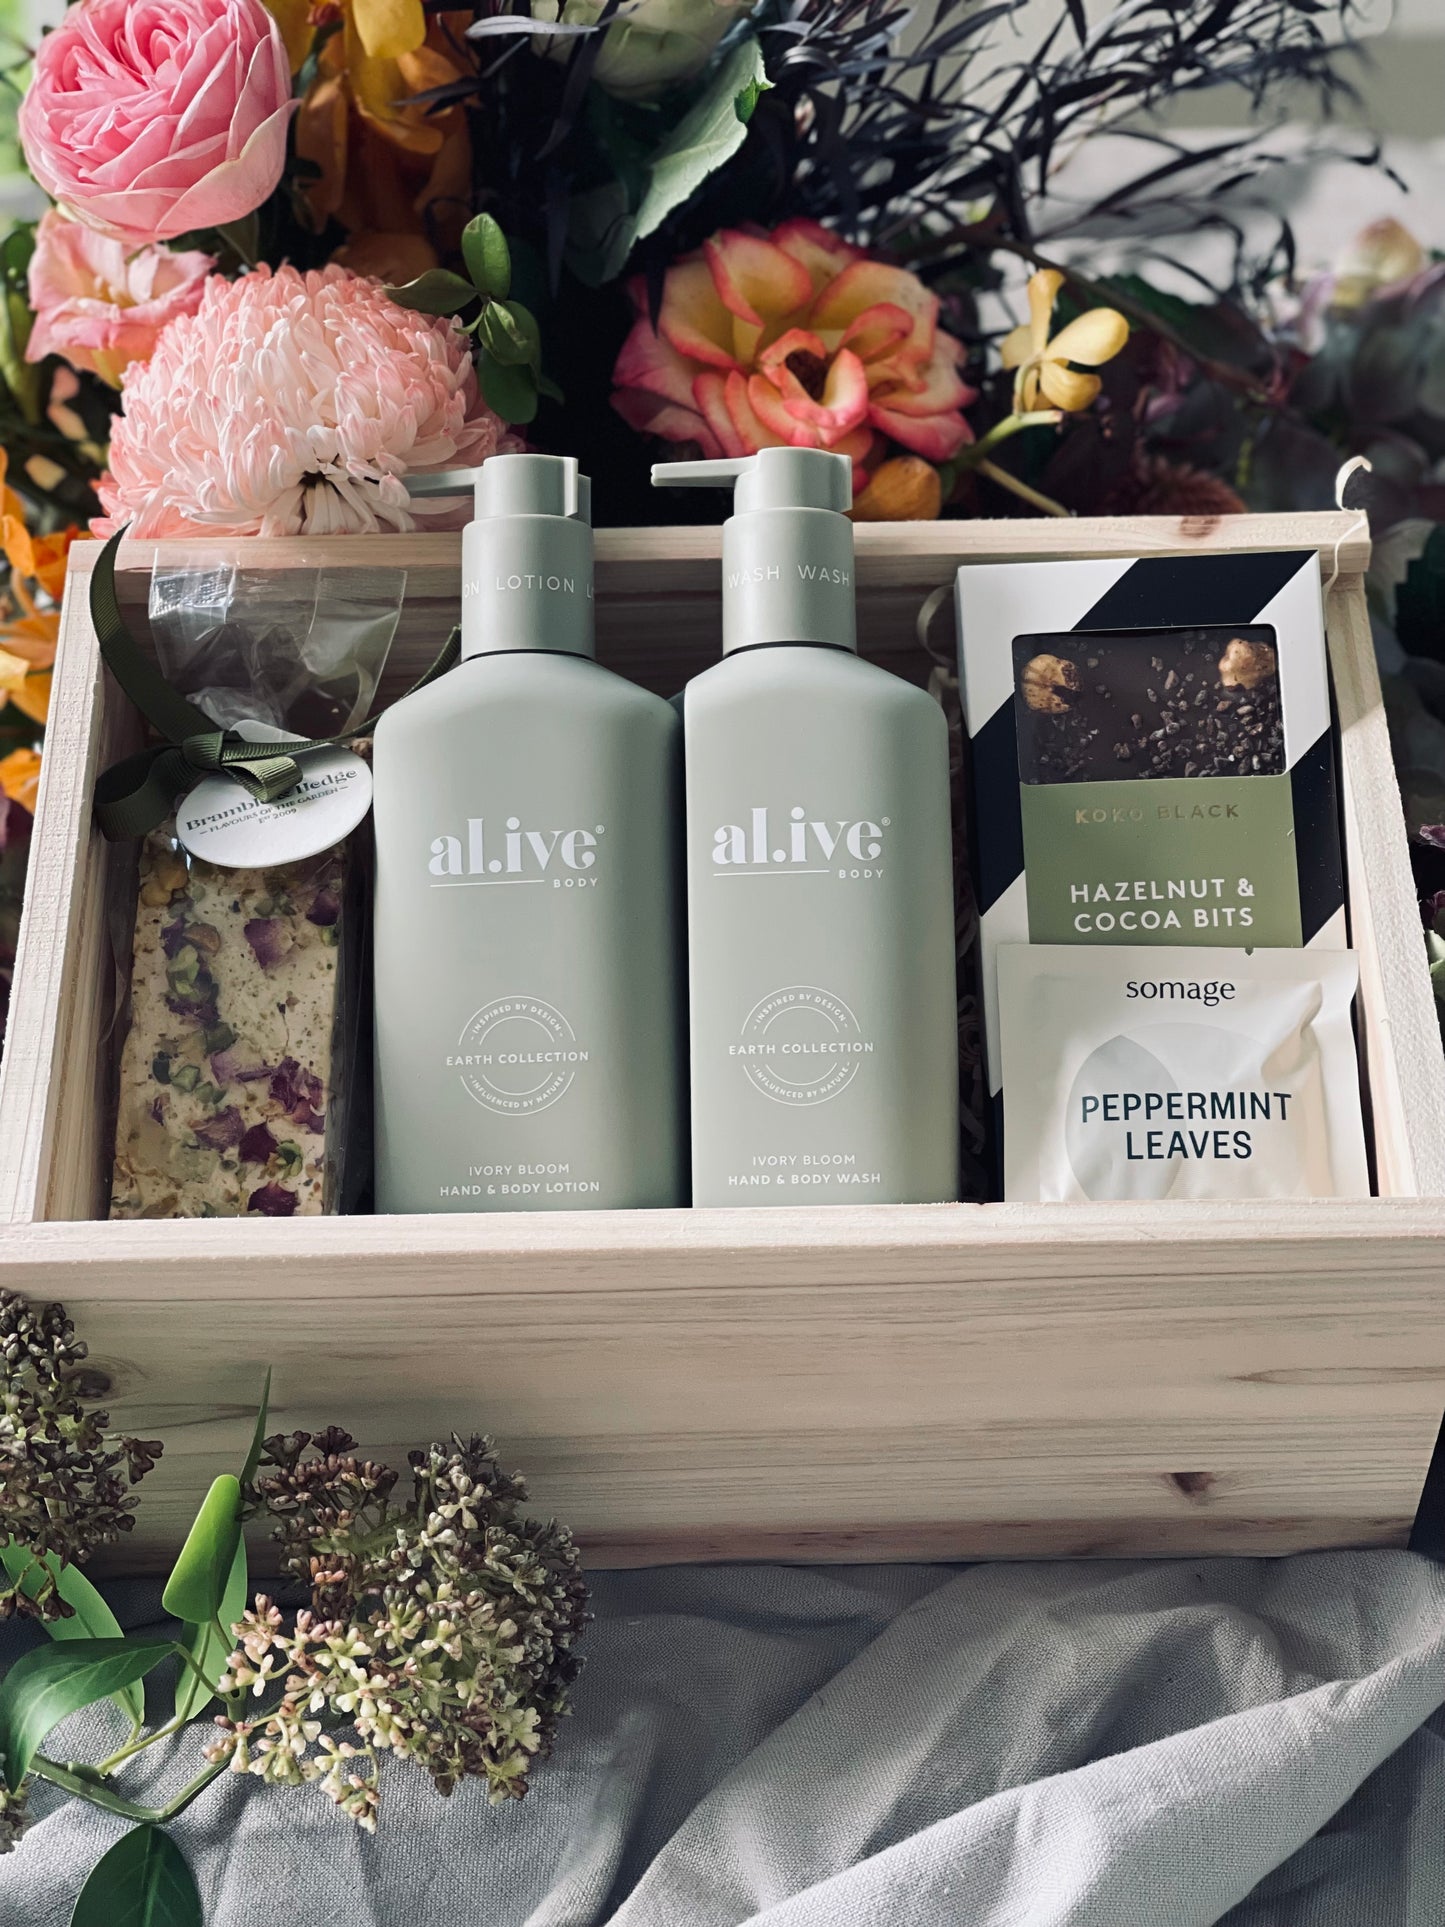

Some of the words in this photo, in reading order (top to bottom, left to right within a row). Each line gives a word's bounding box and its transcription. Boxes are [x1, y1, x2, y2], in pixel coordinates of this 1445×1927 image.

[496, 575, 574, 593] LOTION
[728, 565, 779, 589] WASH
[798, 564, 850, 586] WASH
[186, 798, 265, 831] Brambl
[296, 770, 357, 794] Hedge
[297, 787, 338, 804] GARDEN
[273, 808, 297, 820] 2009
[1075, 808, 1144, 824] KOKO
[1157, 804, 1240, 819] BLACK
[553, 877, 598, 888] BODY
[838, 869, 884, 880] BODY
[1070, 878, 1225, 904] HAZELNUT
[1237, 877, 1255, 897] &
[1074, 910, 1182, 933] COCOA
[1194, 907, 1254, 928] BITS
[1126, 980, 1236, 1007] somage
[472, 1003, 511, 1034] INSPIRED
[515, 1003, 528, 1011] BY
[530, 1005, 562, 1032] DESIGN
[756, 993, 795, 1024] INSPIRED
[799, 993, 812, 1001] BY
[814, 995, 847, 1022] DESIGN
[446, 1054, 493, 1066] EARTH
[498, 1051, 589, 1064] COLLECTION
[729, 1044, 776, 1055] EARTH
[782, 1042, 874, 1054] COLLECTION
[472, 1078, 520, 1109] INFLUENCED
[523, 1099, 534, 1108] BY
[536, 1076, 564, 1103] NATURE
[755, 1068, 804, 1099] INFLUENCED
[806, 1090, 818, 1098] BY
[820, 1066, 849, 1094] NATURE
[1081, 1091, 1293, 1123] PEPPERMINT
[1126, 1130, 1252, 1160] LEAVES
[469, 1165, 513, 1176] IVORY
[518, 1163, 570, 1175] BLOOM
[753, 1155, 797, 1166] IVORY
[803, 1154, 856, 1165] BLOOM
[440, 1185, 482, 1197] HAND
[487, 1184, 496, 1195] &
[501, 1183, 541, 1194] BODY
[546, 1181, 600, 1193] LOTION
[728, 1175, 771, 1186] HAND
[776, 1174, 785, 1185] &
[791, 1174, 831, 1185] BODY
[837, 1173, 881, 1184] WASH
